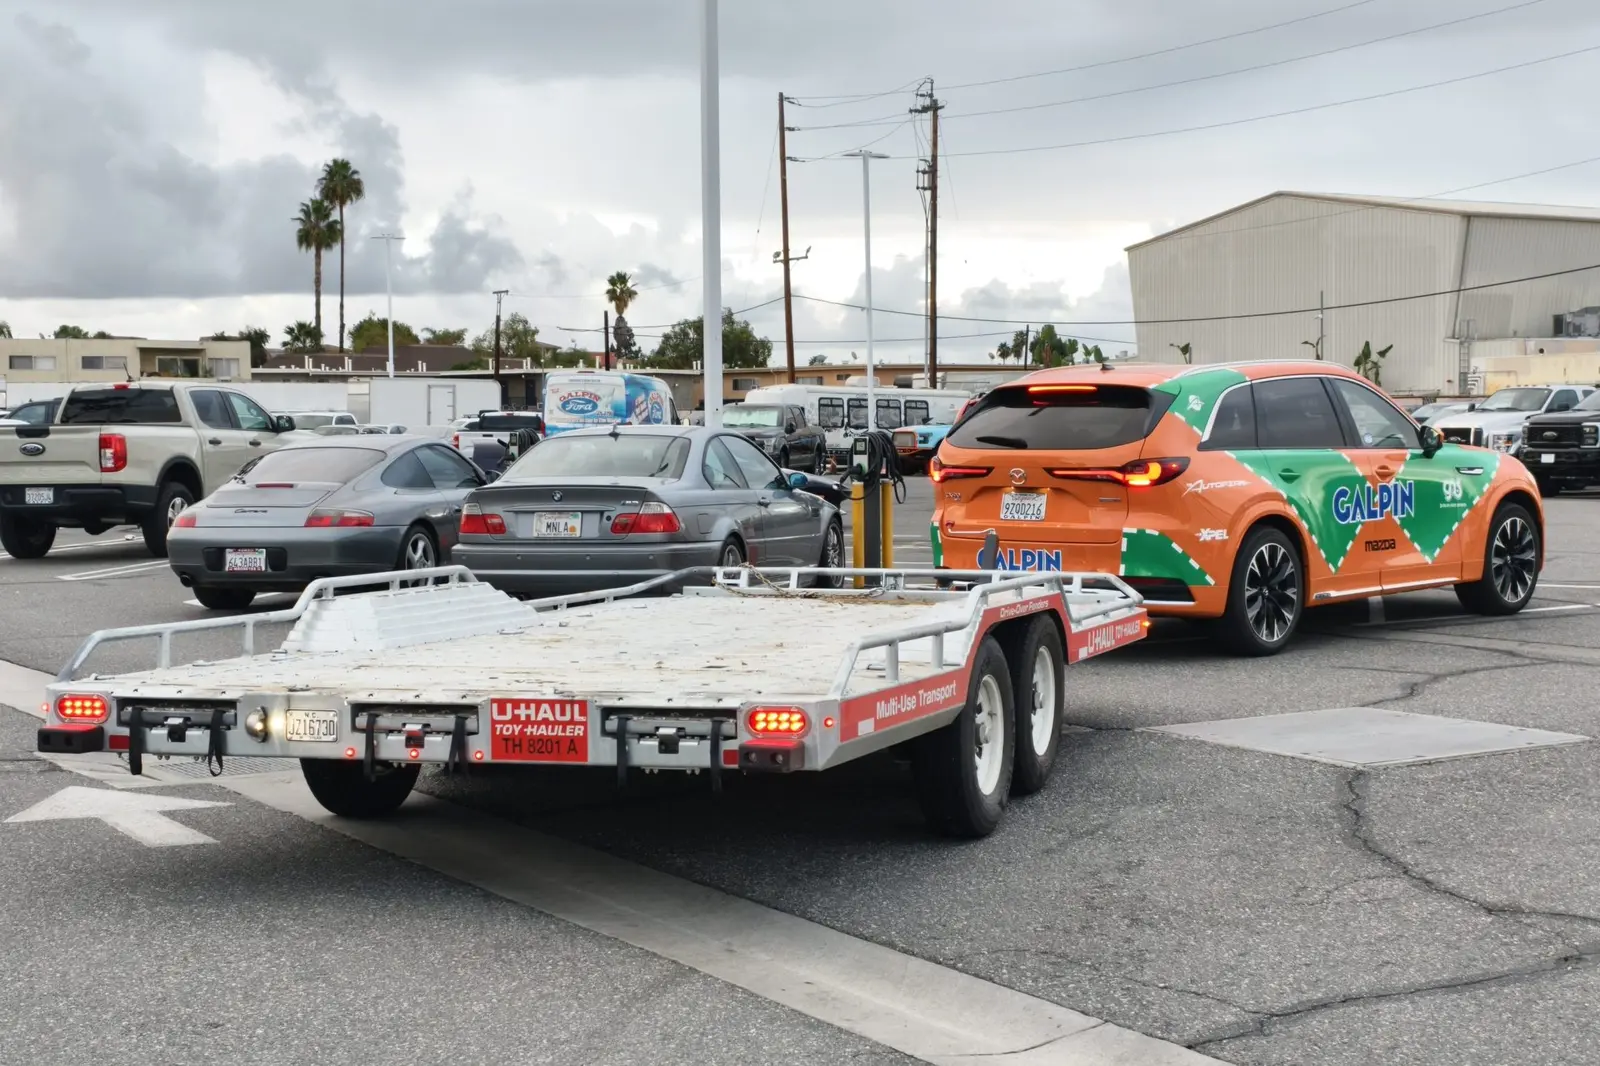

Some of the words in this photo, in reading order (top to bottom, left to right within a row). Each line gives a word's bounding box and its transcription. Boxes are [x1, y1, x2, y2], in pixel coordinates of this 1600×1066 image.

[559, 391, 601, 402] GALPIN
[566, 399, 593, 411] Ford
[1333, 480, 1415, 524] GALPIN
[545, 521, 569, 533] MNLA
[1195, 528, 1229, 542] XPEL
[1365, 538, 1396, 552] mazda
[1087, 625, 1115, 653] U-HAUL
[876, 694, 917, 720] Multi-Use
[918, 679, 956, 707] Transport
[492, 703, 586, 722] U-HAUL
[502, 738, 523, 754] TH
[527, 738, 560, 754] 8201
[567, 739, 578, 755] A
